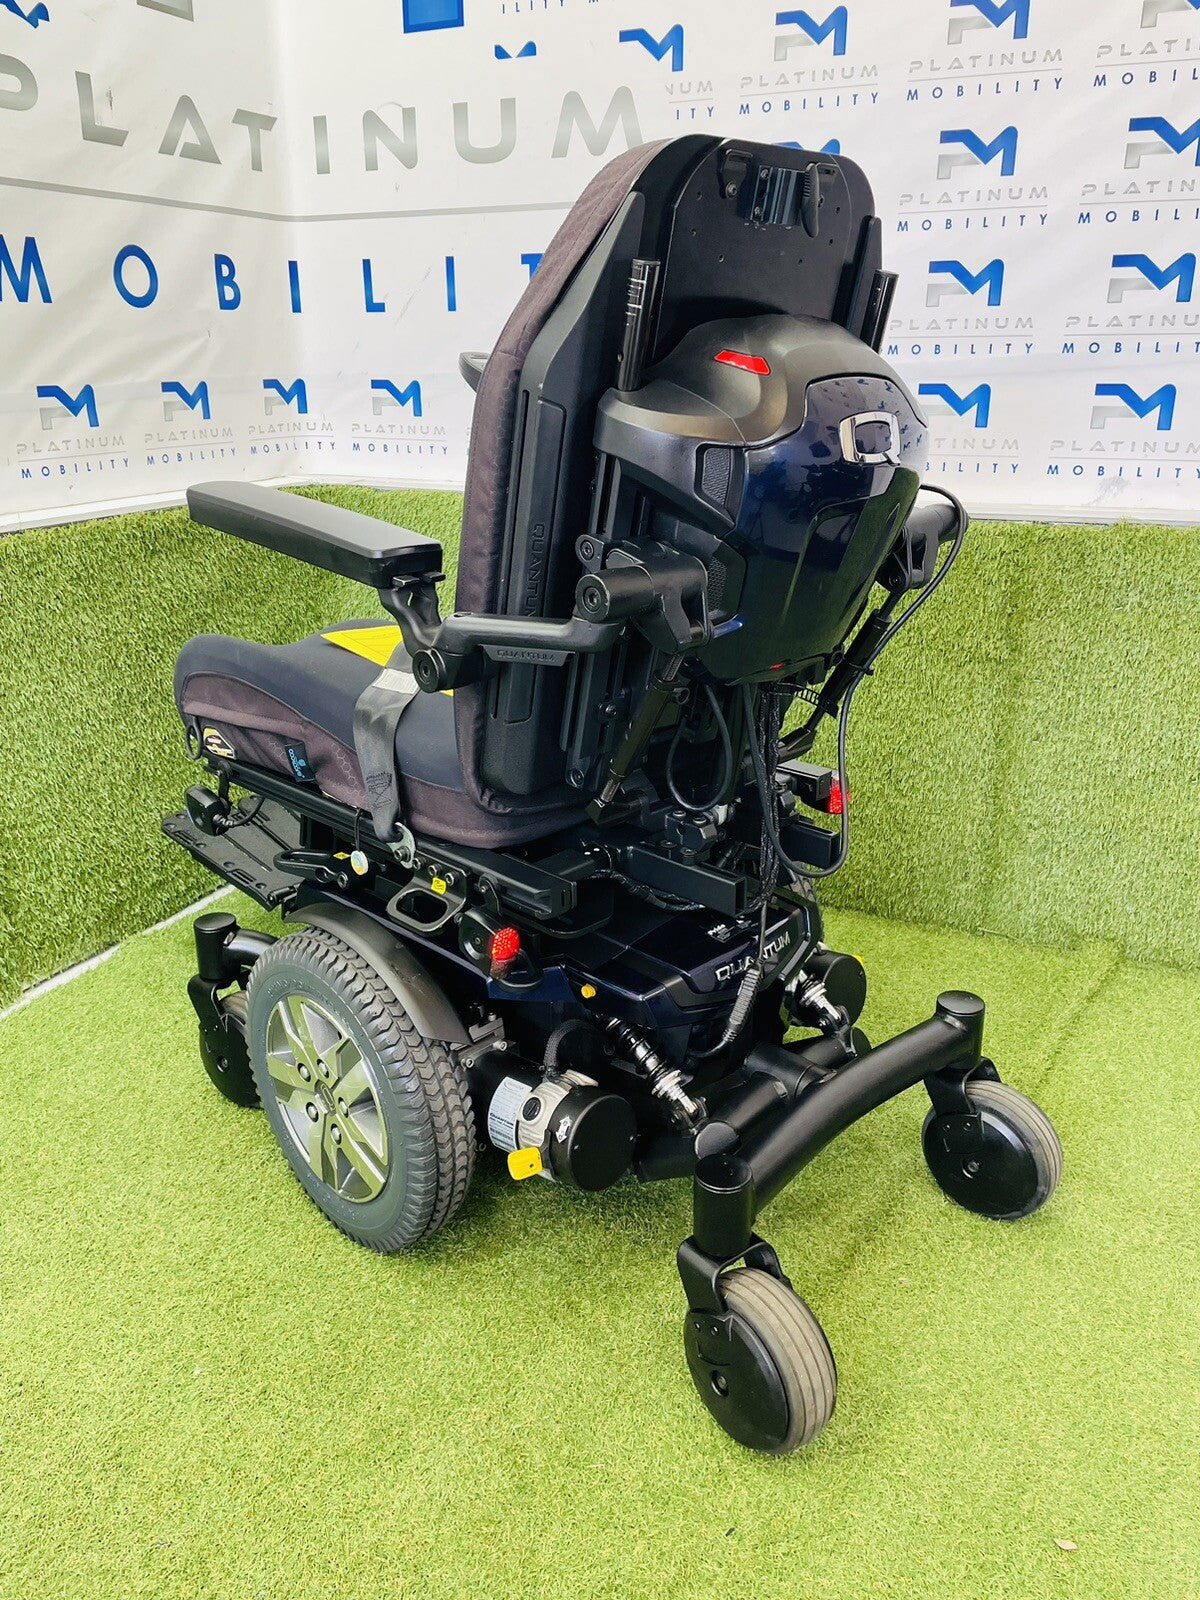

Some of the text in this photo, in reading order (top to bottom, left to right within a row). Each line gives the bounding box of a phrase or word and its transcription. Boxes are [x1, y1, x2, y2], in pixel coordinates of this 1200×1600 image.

[1097, 39, 1192, 58] PLATI
[909, 48, 1063, 74] PLATINUM
[740, 64, 879, 89] PLATINUM
[1094, 68, 1199, 87] MOBIL
[907, 78, 1063, 101] MOBILITY
[739, 92, 879, 115] MOBILITY
[898, 186, 1049, 206] PLATINUM
[1081, 180, 1196, 197] PLATIN
[897, 213, 1049, 232] MOBILITY
[1078, 208, 1200, 224] MOBILI
[889, 316, 1034, 330] PLATINUM
[1065, 314, 1200, 328] PLATINU
[887, 342, 1034, 355] MOBILITY
[1062, 341, 1200, 354] MOBILIT
[144, 427, 234, 443] PLATINUM
[249, 421, 335, 436] PLATINUM
[351, 423, 447, 436] PLATINUM
[16, 435, 126, 455] PLATINUM
[250, 441, 336, 456] MOBILITY
[352, 442, 449, 455] MOBILITY
[934, 438, 1020, 451] TINUM
[146, 448, 237, 466] MOBILITY
[21, 458, 130, 479] MOBILITY
[925, 462, 1020, 474] BILITY
